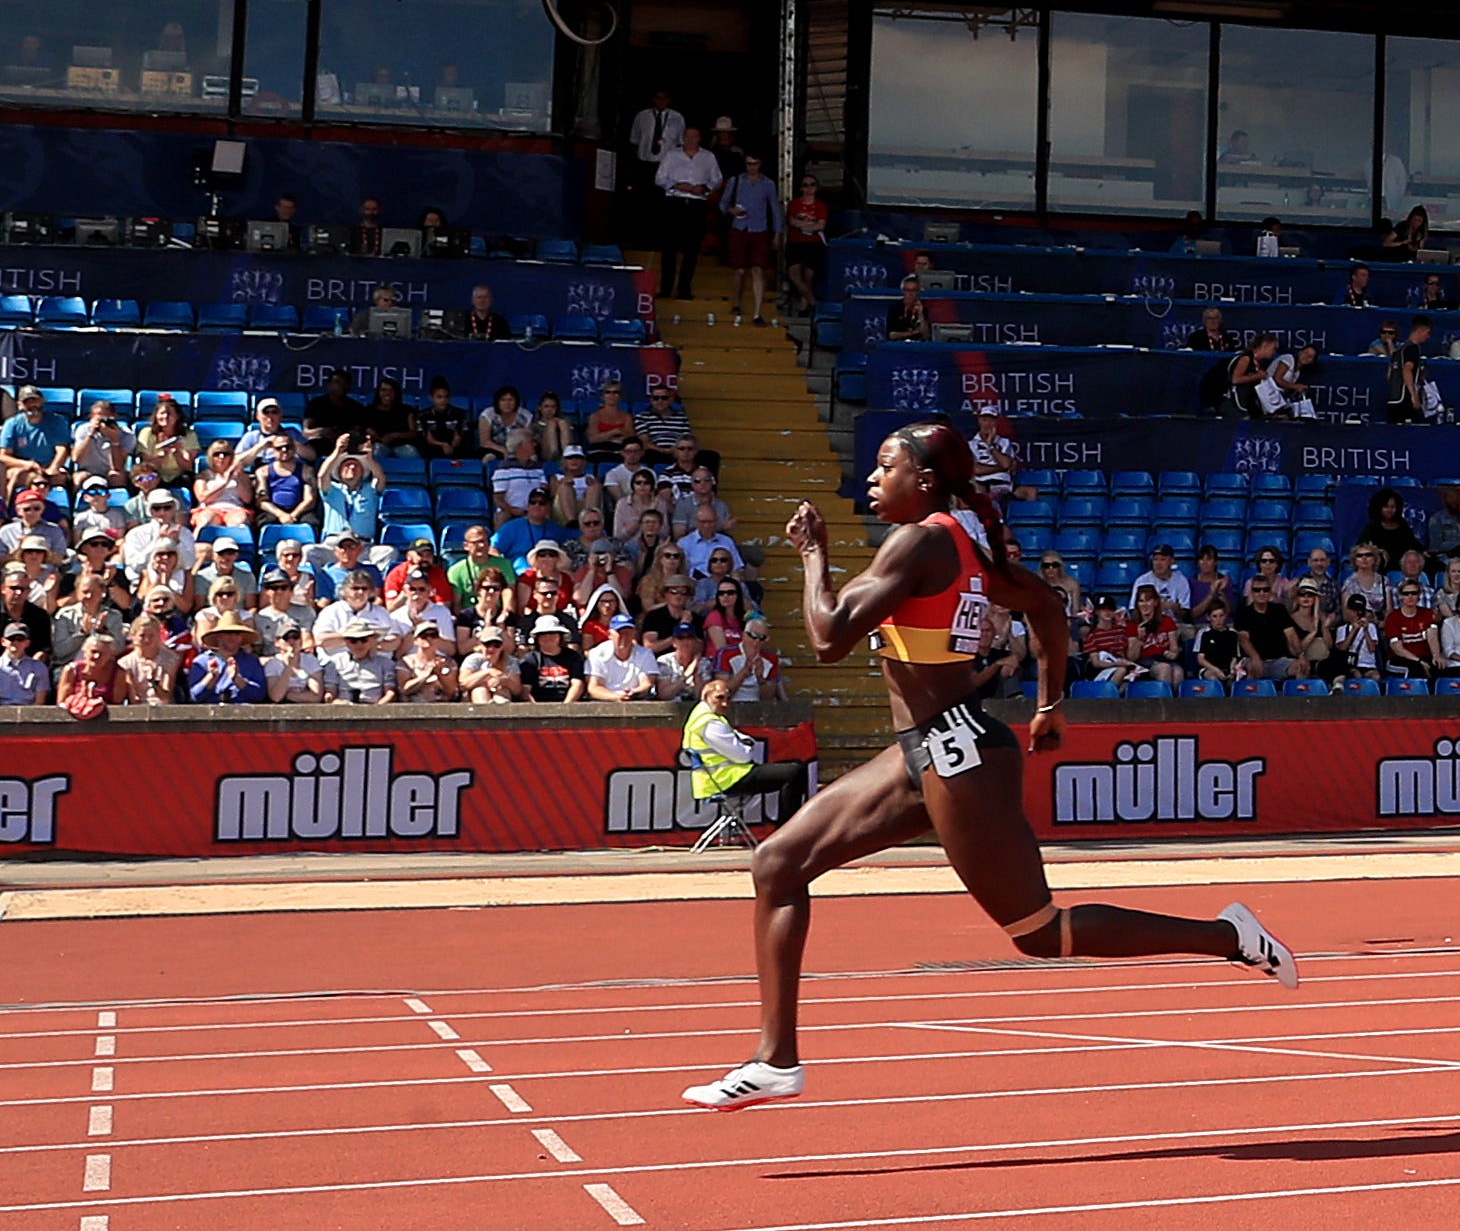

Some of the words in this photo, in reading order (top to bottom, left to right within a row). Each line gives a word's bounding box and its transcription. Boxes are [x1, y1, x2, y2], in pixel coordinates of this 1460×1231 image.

[0, 268, 82, 292] ITISH
[307, 278, 429, 303] BRITSH
[955, 274, 1013, 293] TISH
[974, 322, 1040, 343] TISH
[962, 372, 1075, 394] BRITISH
[1310, 385, 1371, 407] TISH
[1010, 441, 1102, 464] RITISH
[1303, 446, 1411, 470] BRITISH
[941, 736, 966, 768] 5
[1056, 738, 1264, 822] müller
[216, 747, 472, 840] müller
